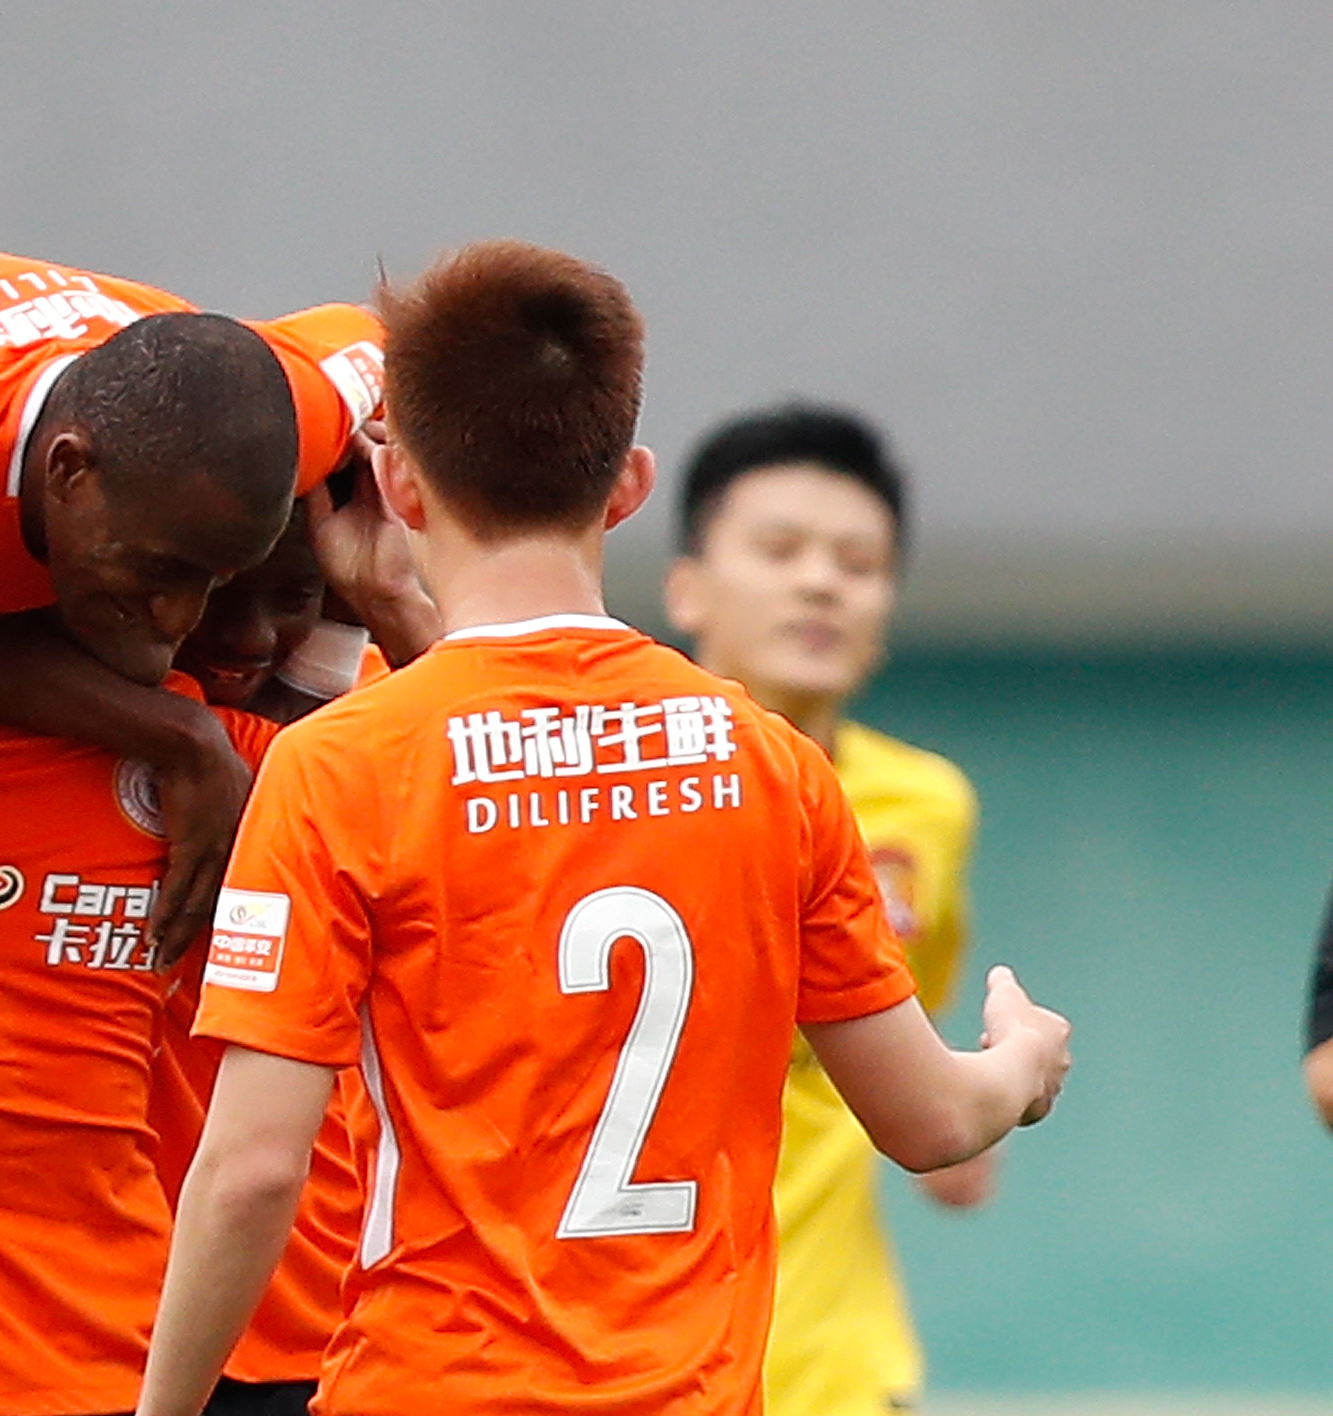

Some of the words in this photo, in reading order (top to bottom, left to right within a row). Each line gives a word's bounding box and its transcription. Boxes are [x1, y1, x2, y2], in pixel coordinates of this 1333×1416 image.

[446, 696, 737, 787] 地利生鲜
[466, 773, 742, 834] DILIFRESH
[39, 873, 160, 918] Cara
[557, 885, 698, 1239] 2
